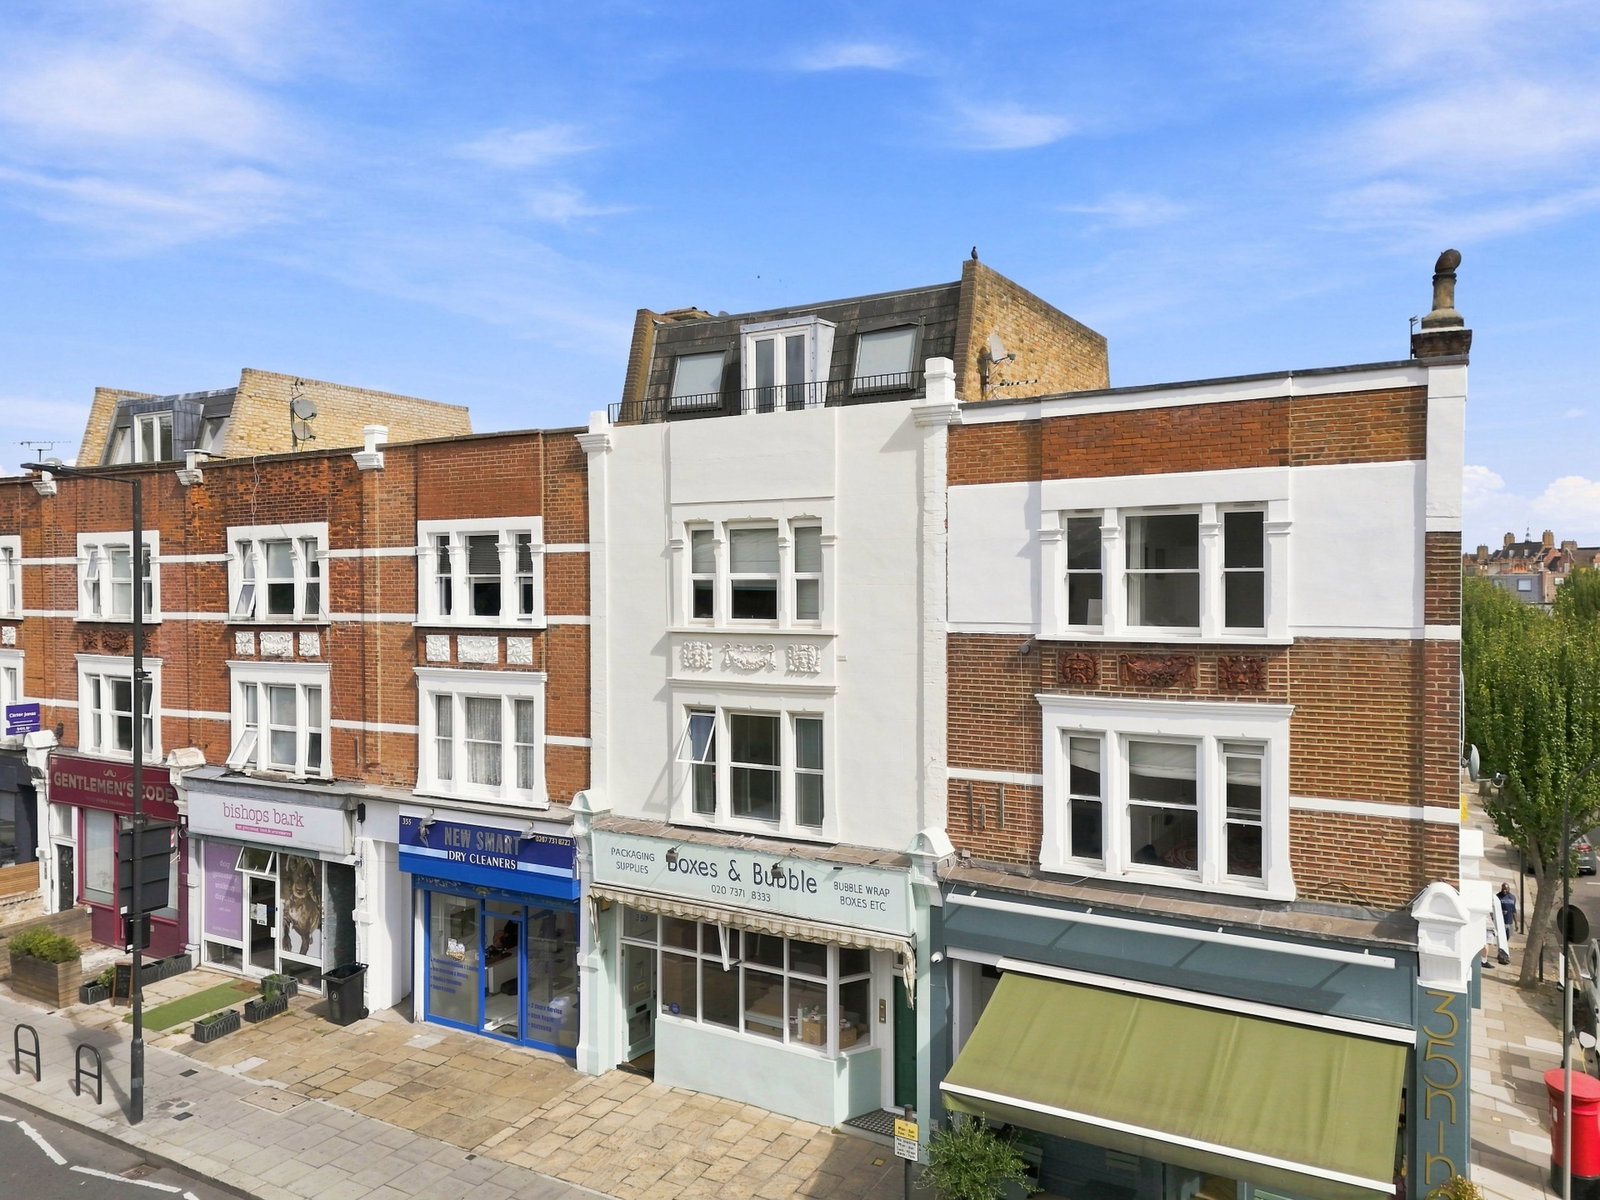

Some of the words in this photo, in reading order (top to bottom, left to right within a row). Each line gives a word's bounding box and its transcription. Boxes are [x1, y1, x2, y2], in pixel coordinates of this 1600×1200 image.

[53, 771, 133, 799] GENTLEMEN'S
[222, 802, 269, 825] bishops
[273, 807, 305, 828] bark
[402, 817, 412, 826] 355
[444, 826, 471, 849] NEW
[476, 831, 521, 856] SMART
[448, 850, 467, 862] DRY
[469, 853, 517, 870] CLEANERS
[611, 847, 656, 862] PACKAGING
[616, 860, 649, 875] SUPPLIES
[728, 859, 742, 882] &
[753, 862, 818, 895] Bubble
[711, 884, 727, 895] 020
[729, 886, 746, 898] 7371
[751, 891, 771, 903] 8333
[833, 880, 863, 894] BUBBLE
[865, 886, 891, 898] WRAP
[839, 896, 868, 909] BOXES
[870, 901, 887, 912] ETC
